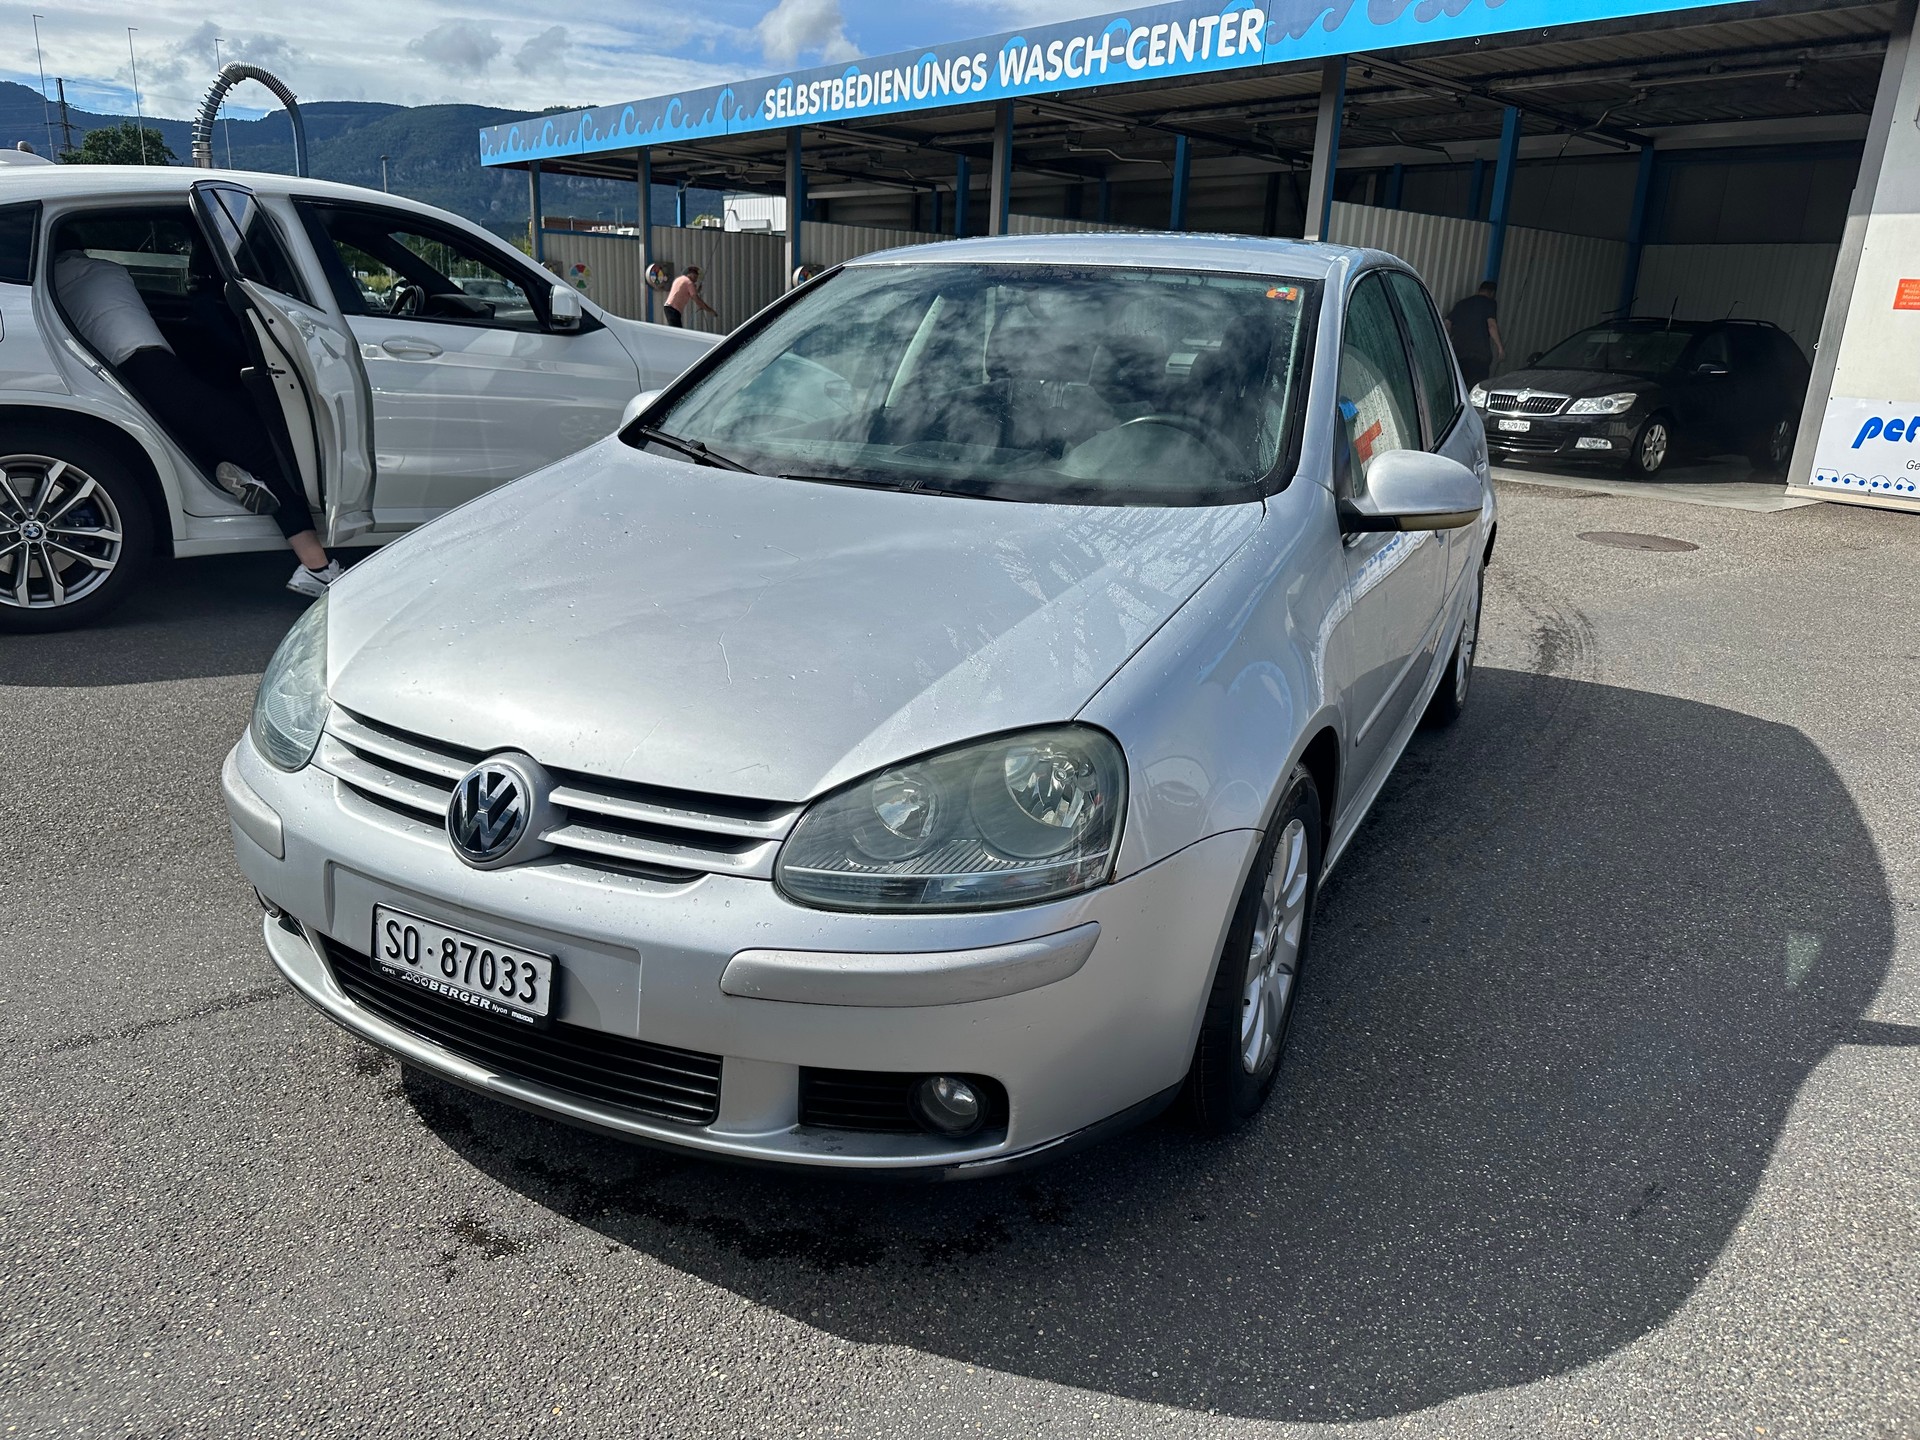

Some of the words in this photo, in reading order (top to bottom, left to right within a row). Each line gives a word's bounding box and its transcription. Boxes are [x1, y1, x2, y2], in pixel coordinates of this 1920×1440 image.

[765, 53, 988, 121] SELBSTBEDIENUNGS
[999, 8, 1265, 87] WASCH-CENTER
[429, 980, 491, 1010] BERGER
[492, 1003, 508, 1014] Nyon
[440, 937, 536, 1003] 87033
